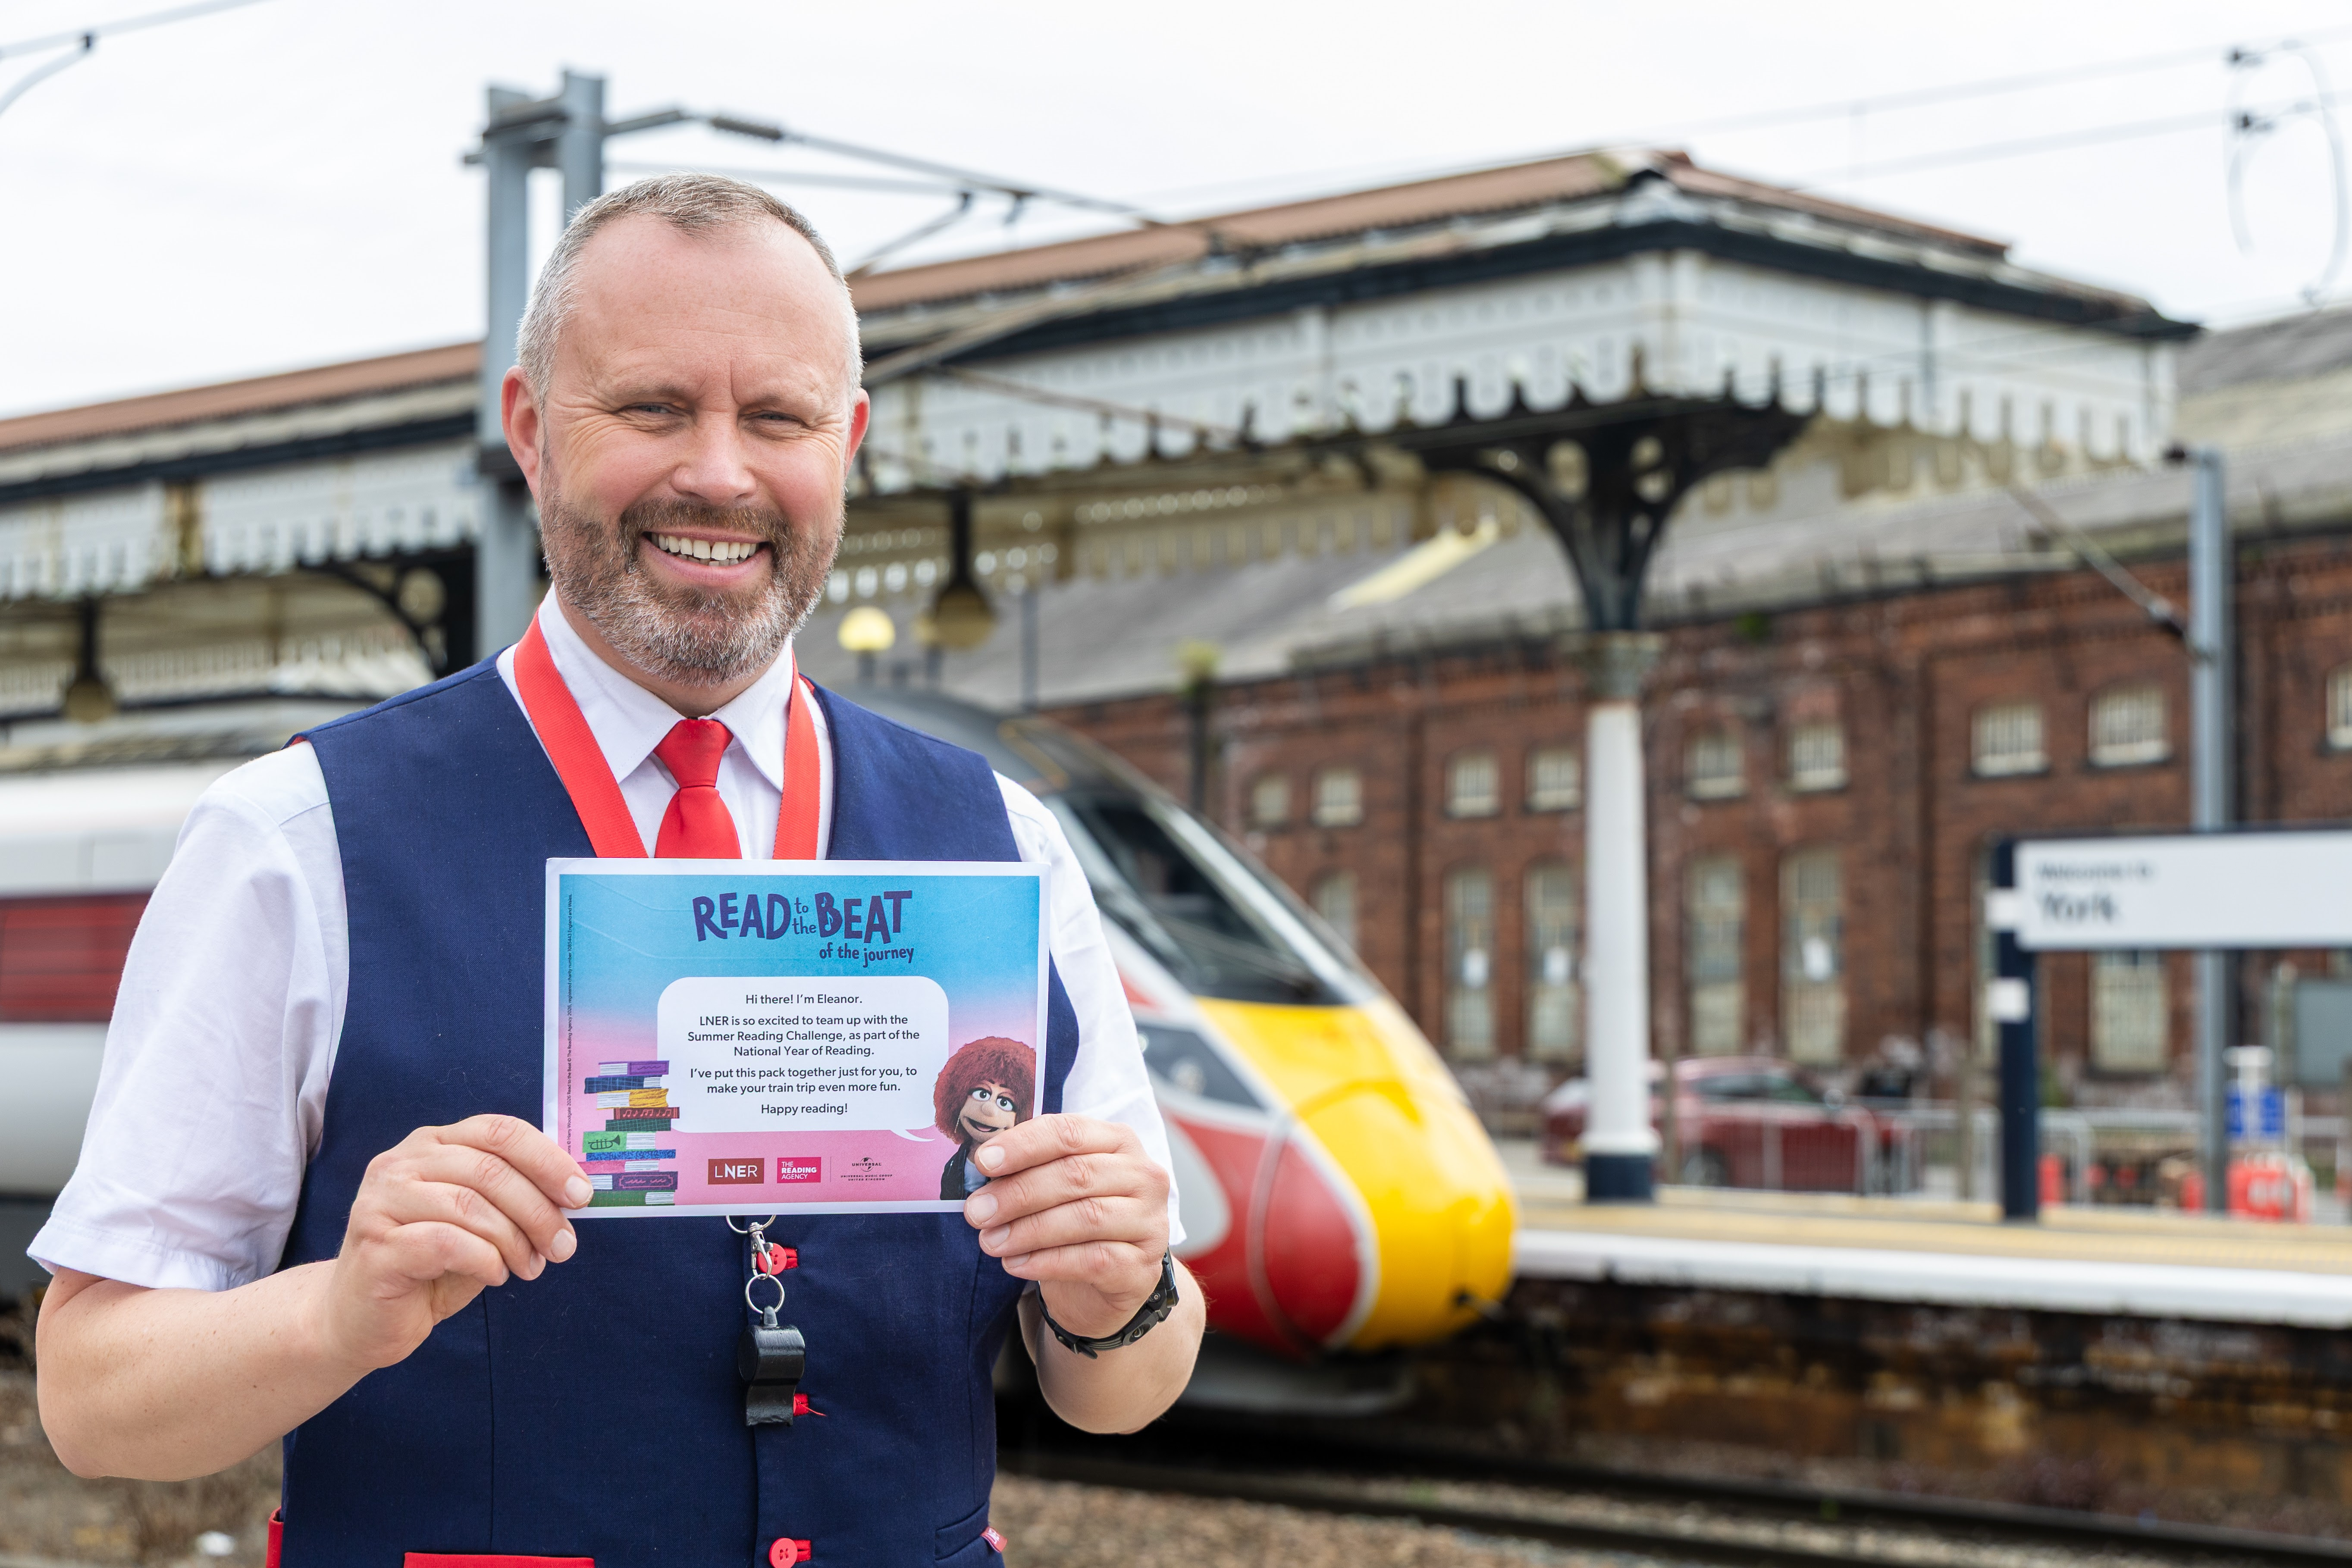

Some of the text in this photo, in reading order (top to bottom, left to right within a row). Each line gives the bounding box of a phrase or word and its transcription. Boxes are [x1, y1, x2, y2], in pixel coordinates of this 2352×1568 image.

[2042, 892, 2119, 922] York
[692, 891, 912, 944] READ to the BEAT
[819, 942, 914, 968] of the journey
[746, 994, 757, 1004] Hi
[760, 994, 793, 1004] there!
[818, 994, 862, 1004] Eleanor.
[700, 1016, 729, 1026] LNER
[731, 1016, 740, 1025] is
[758, 1015, 799, 1025] excited
[802, 1016, 813, 1025] to
[815, 1016, 844, 1025] team
[847, 1017, 861, 1027] up
[863, 1015, 887, 1024] with
[890, 1015, 908, 1024] the
[688, 1032, 735, 1041] Summer
[737, 1031, 783, 1043] Reading
[786, 1031, 846, 1042] Challenge,
[863, 1031, 886, 1042] part
[888, 1030, 900, 1039] of
[901, 1029, 920, 1039] the
[734, 1045, 874, 1057] National Year of Reading.
[715, 1069, 734, 1080] put
[736, 1067, 756, 1078] this
[759, 1067, 785, 1079] pack
[787, 1067, 837, 1079] together
[838, 1066, 859, 1079] just
[861, 1066, 877, 1076] for
[878, 1069, 903, 1078] you,
[906, 1067, 917, 1076] to
[707, 1083, 738, 1093] make
[740, 1085, 766, 1095] your
[768, 1082, 793, 1092] train
[796, 1082, 816, 1094] trip
[879, 1081, 900, 1091] fun.
[761, 1103, 847, 1116] Happy reading!
[715, 1163, 758, 1179] LNER
